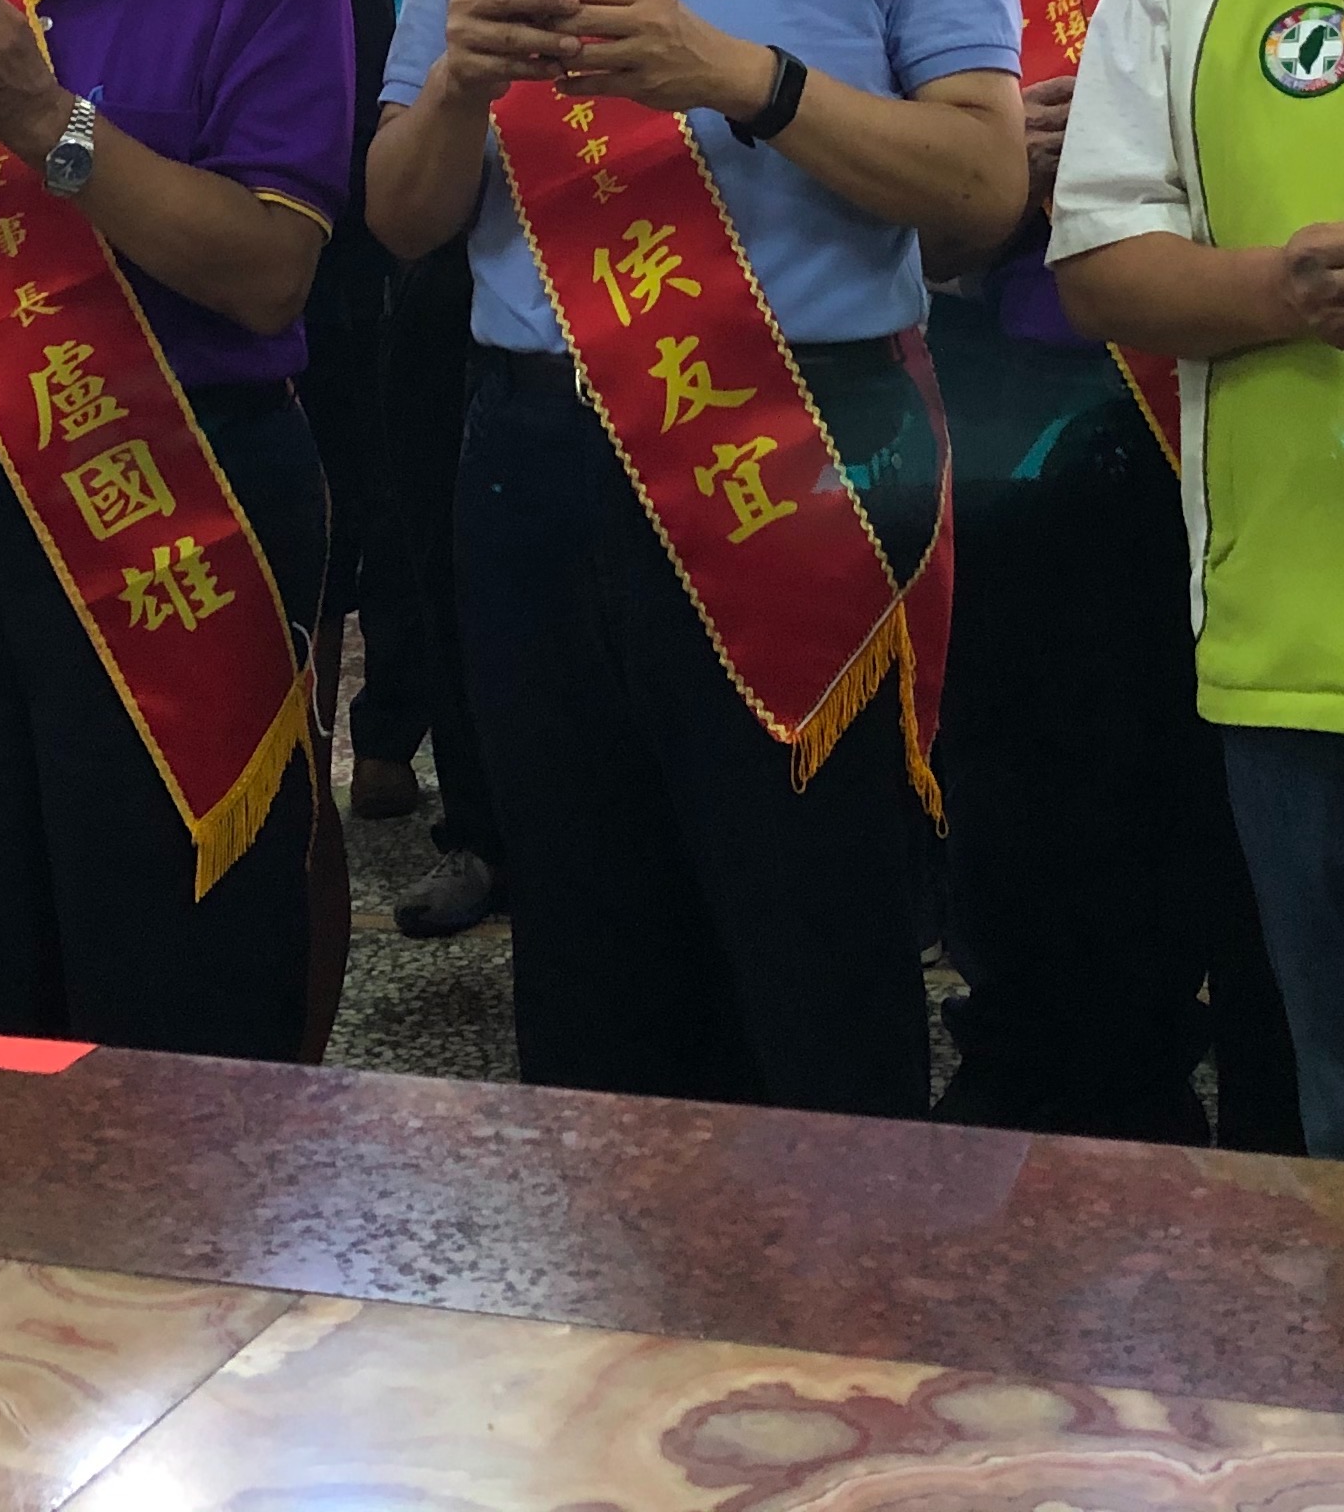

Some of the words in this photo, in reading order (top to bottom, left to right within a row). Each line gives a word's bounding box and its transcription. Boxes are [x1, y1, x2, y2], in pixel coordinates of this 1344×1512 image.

[552, 86, 628, 204] 市市長
[26, 339, 236, 632] 盧國雄
[592, 219, 799, 545] 侯友宜
